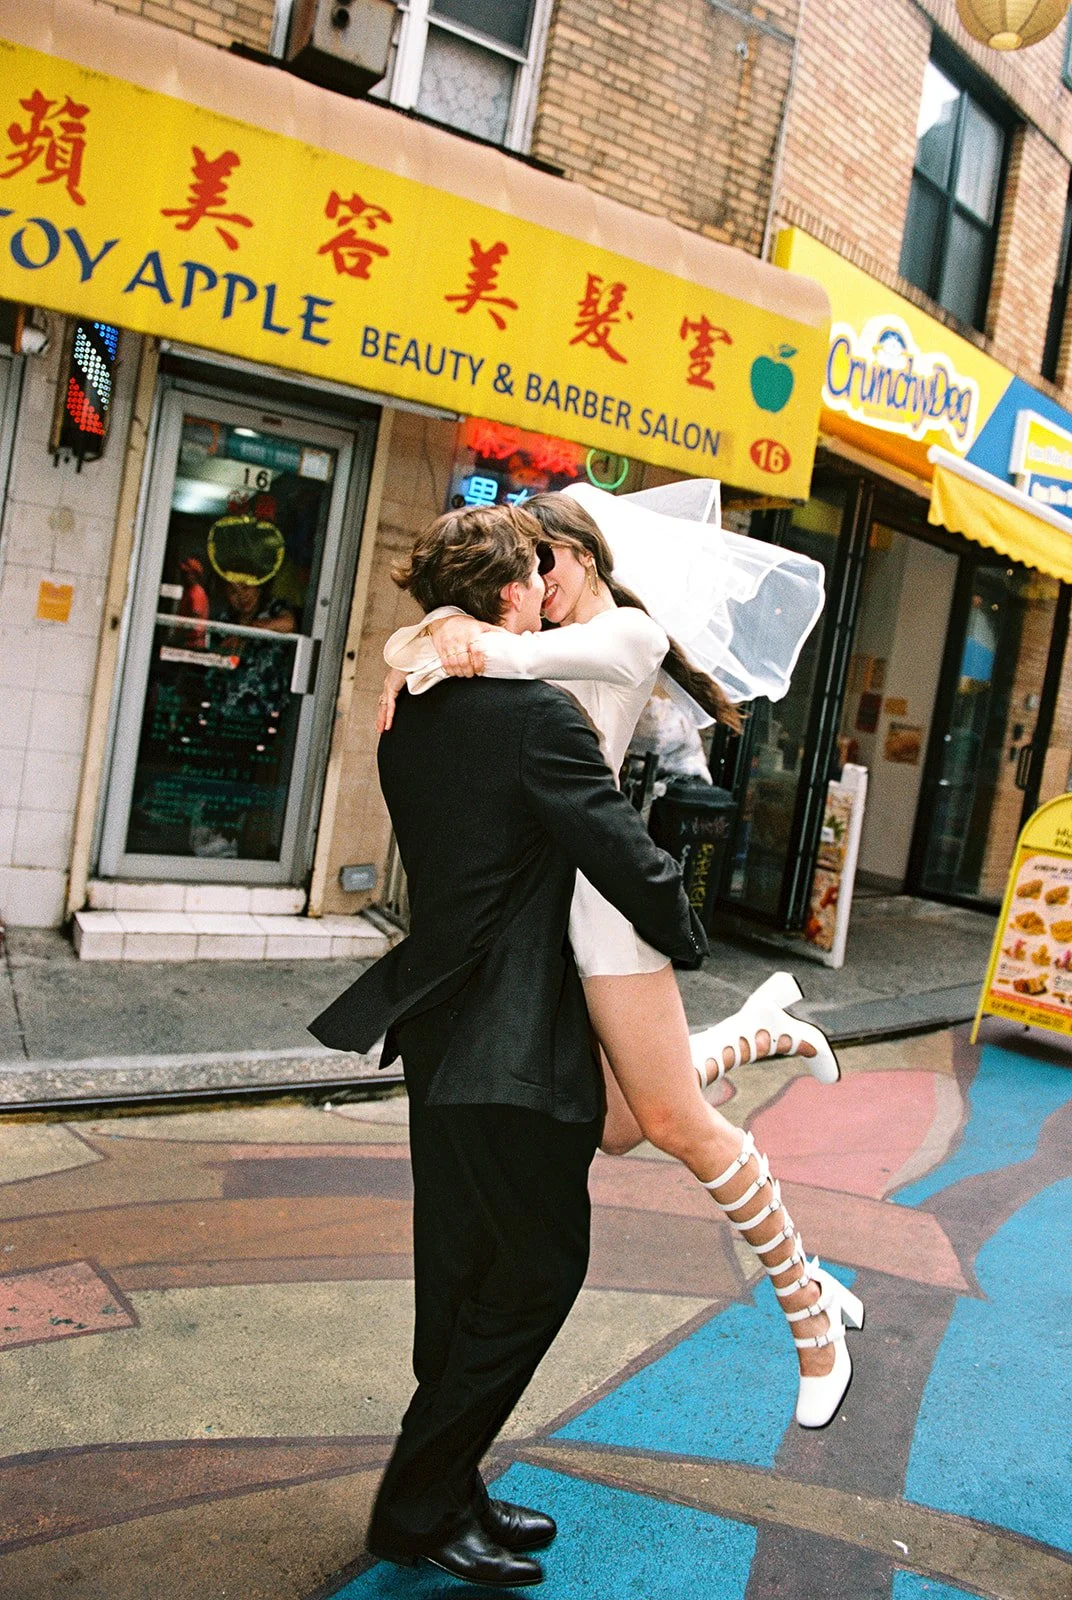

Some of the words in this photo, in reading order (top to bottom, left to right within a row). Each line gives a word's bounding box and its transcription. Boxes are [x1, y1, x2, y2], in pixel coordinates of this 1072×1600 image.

[122, 250, 335, 346] APPLE
[360, 326, 486, 385] BEAUTY
[493, 363, 515, 396] &
[525, 373, 632, 431] BARBER
[638, 407, 721, 457] SALON
[757, 441, 785, 473] 16
[243, 467, 269, 489] 16
